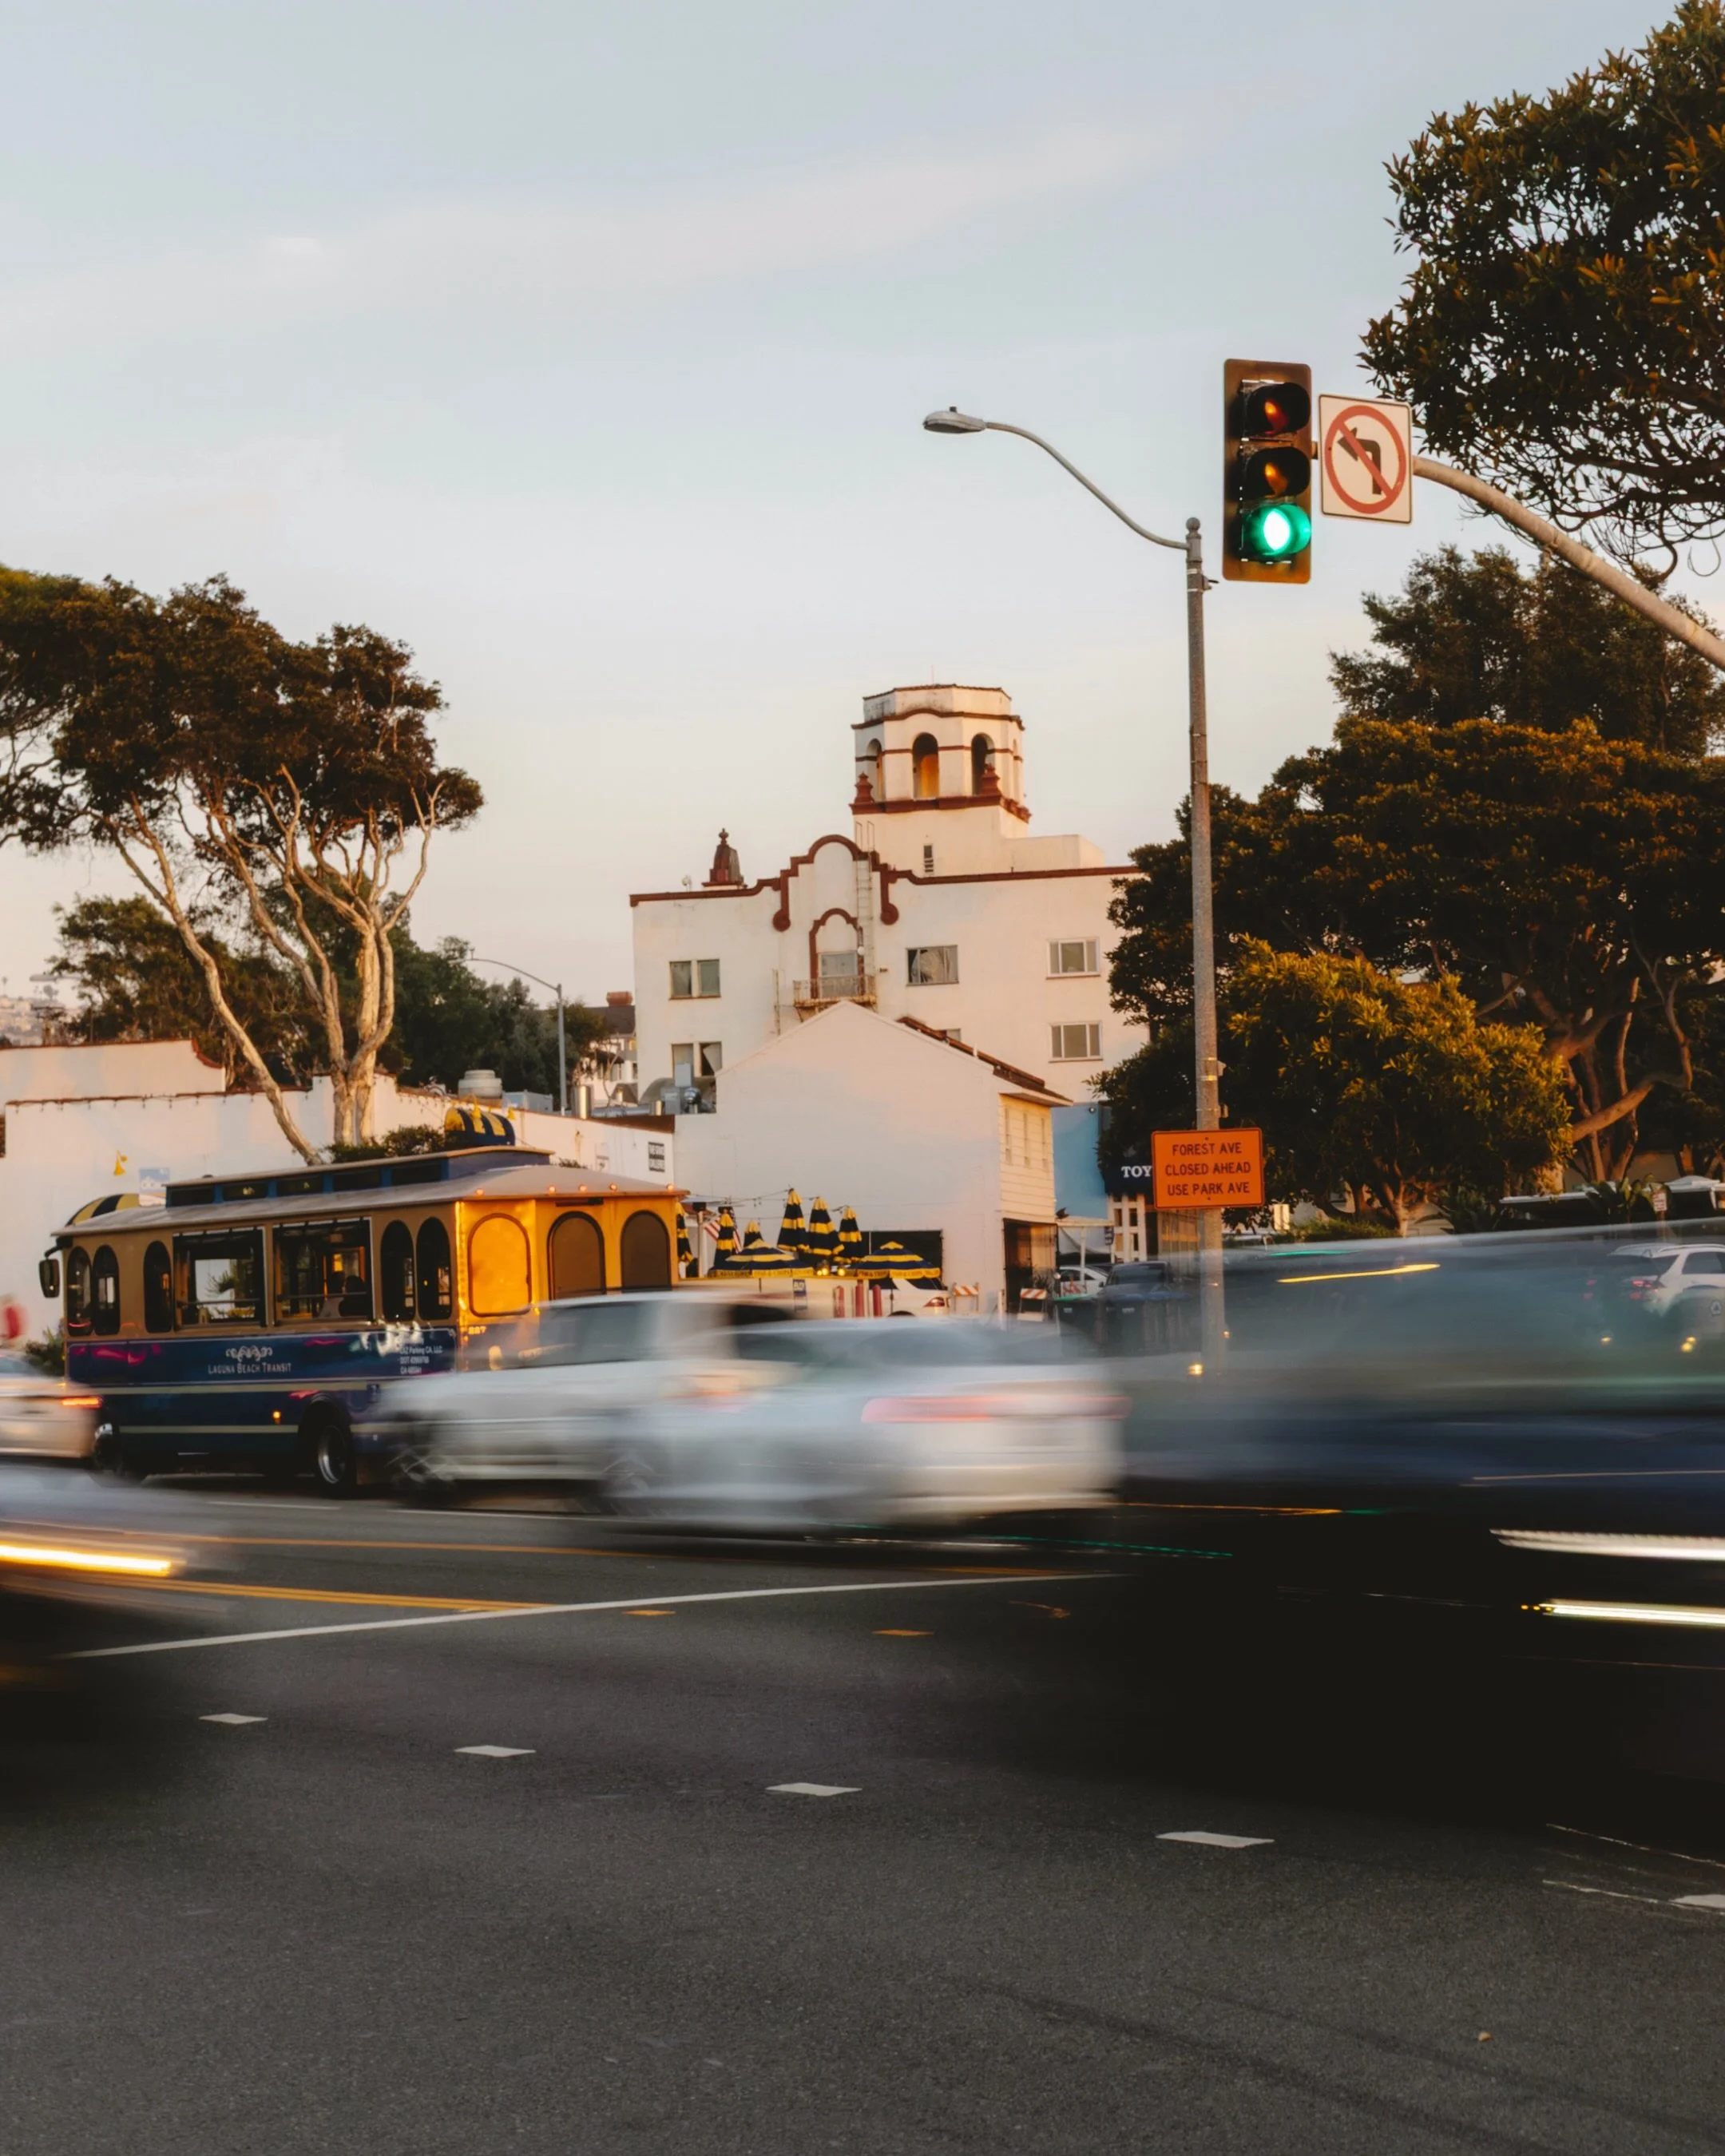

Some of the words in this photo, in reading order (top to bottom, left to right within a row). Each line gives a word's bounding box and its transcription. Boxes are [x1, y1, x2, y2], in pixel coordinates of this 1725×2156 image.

[1172, 1143, 1215, 1156] FOREST
[1219, 1142, 1242, 1154] AVE
[1165, 1163, 1208, 1176] CLOSED
[1212, 1162, 1251, 1174] AHEAD
[1168, 1183, 1189, 1196] USE
[1192, 1183, 1223, 1195] PARK
[1227, 1182, 1250, 1194] AVE
